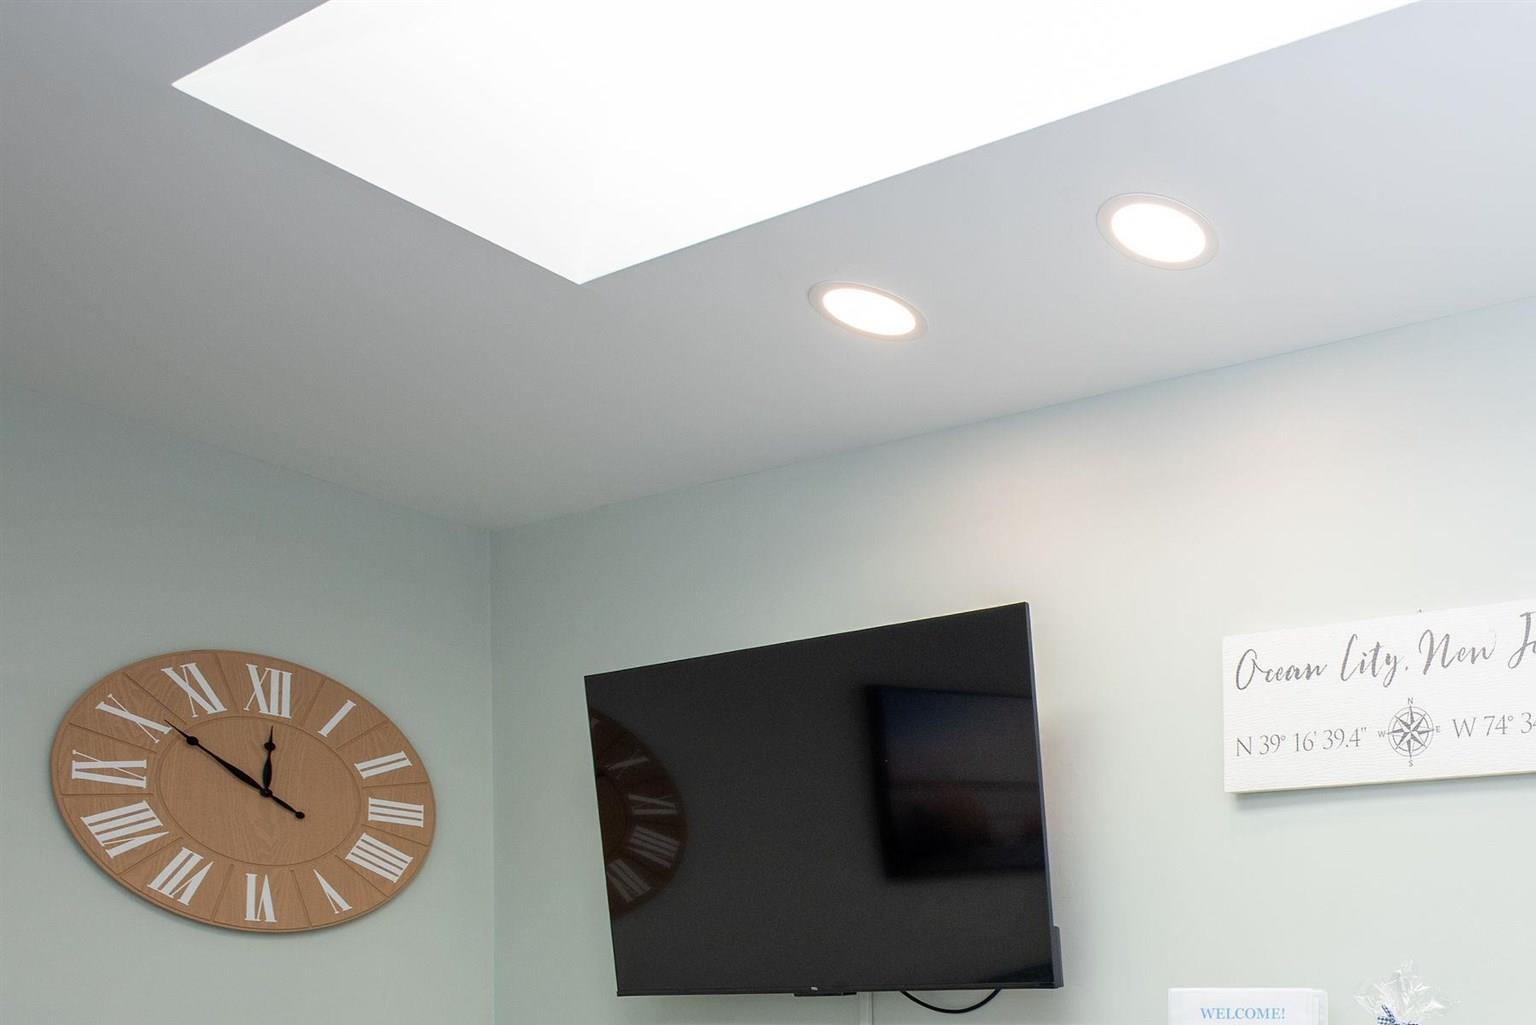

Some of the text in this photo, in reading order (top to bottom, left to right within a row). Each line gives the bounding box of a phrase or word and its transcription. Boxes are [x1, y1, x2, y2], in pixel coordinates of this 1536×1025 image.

[1235, 648, 1327, 690] Ocean
[1418, 629, 1497, 676] New
[161, 662, 228, 718] XI
[243, 663, 292, 718] XII
[96, 693, 173, 744] X
[1452, 717, 1477, 739] W
[1484, 714, 1514, 736] 74°
[354, 750, 413, 779] II
[1236, 736, 1252, 757] N
[1259, 733, 1286, 755] 39°
[71, 749, 147, 789] IX
[80, 799, 170, 859] VIII
[368, 796, 425, 828] III
[147, 847, 214, 906] VII
[245, 873, 277, 923] VI
[313, 869, 353, 914] V
[1200, 1007, 1286, 1020] WELCOME!
